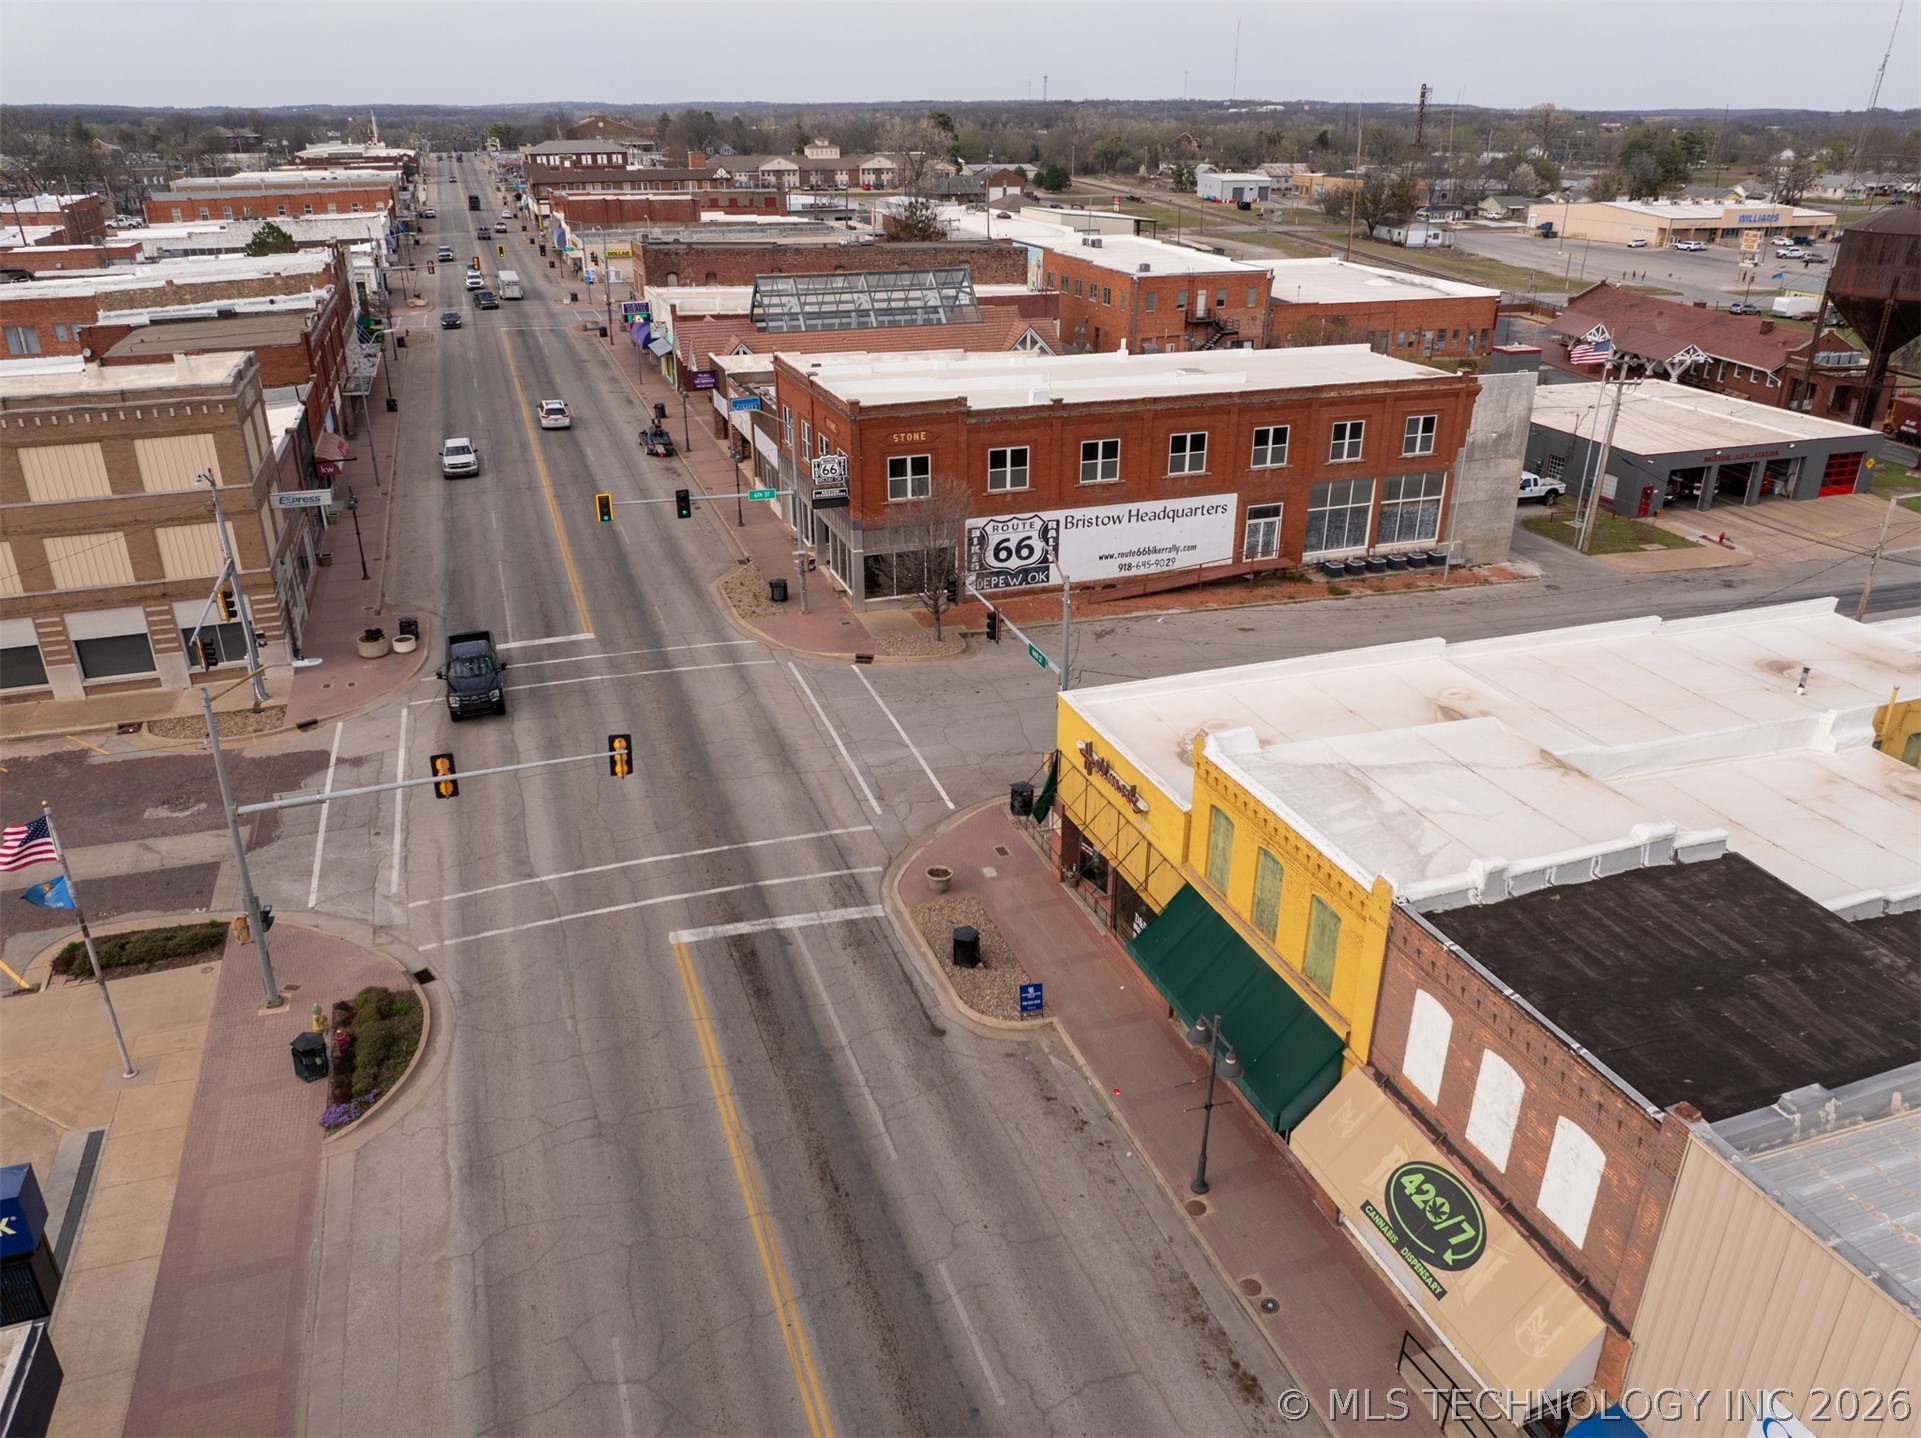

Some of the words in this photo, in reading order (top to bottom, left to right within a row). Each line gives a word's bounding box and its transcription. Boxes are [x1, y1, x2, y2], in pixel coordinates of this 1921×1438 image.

[1738, 213, 1780, 223] WILLIAMS
[892, 431, 927, 443] STONE
[822, 464, 838, 476] 66
[279, 495, 321, 505] Express
[1063, 512, 1125, 531] Bristow
[1127, 503, 1228, 524] Headquarters
[992, 521, 1036, 533] ROUTE
[993, 535, 1035, 564] 66
[1098, 543, 1198, 561] www.route66bikerrally.com
[1117, 557, 1177, 573] 918-645-9029
[1027, 570, 1049, 584] OK
[1365, 1205, 1399, 1244] CANNABIS
[1400, 1246, 1443, 1294] DISPENSARY
